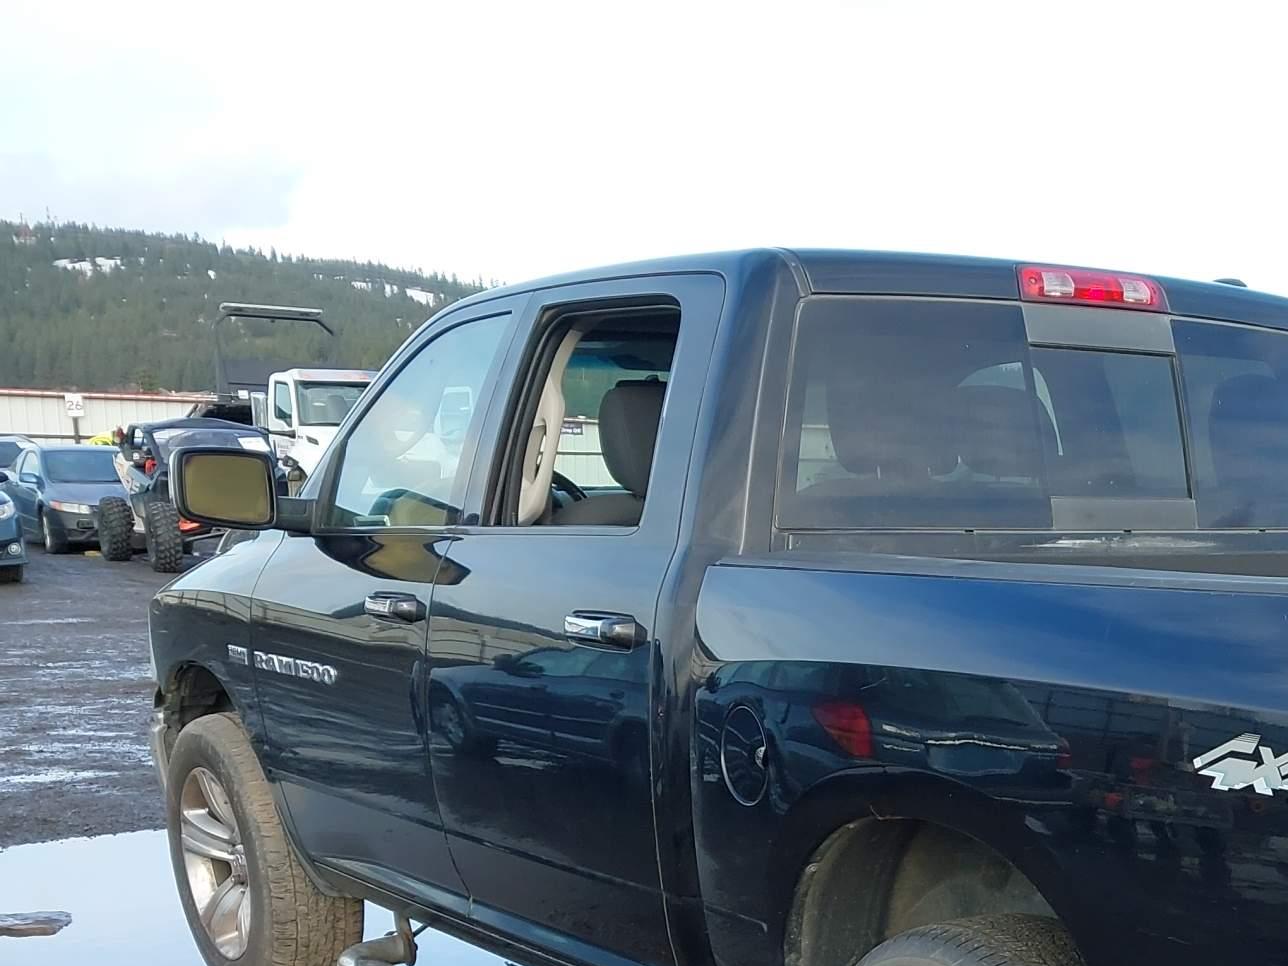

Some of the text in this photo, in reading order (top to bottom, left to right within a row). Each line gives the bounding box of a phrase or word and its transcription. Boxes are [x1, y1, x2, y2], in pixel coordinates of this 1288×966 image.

[67, 400, 82, 411] 26
[253, 651, 338, 685] RAM 1500
